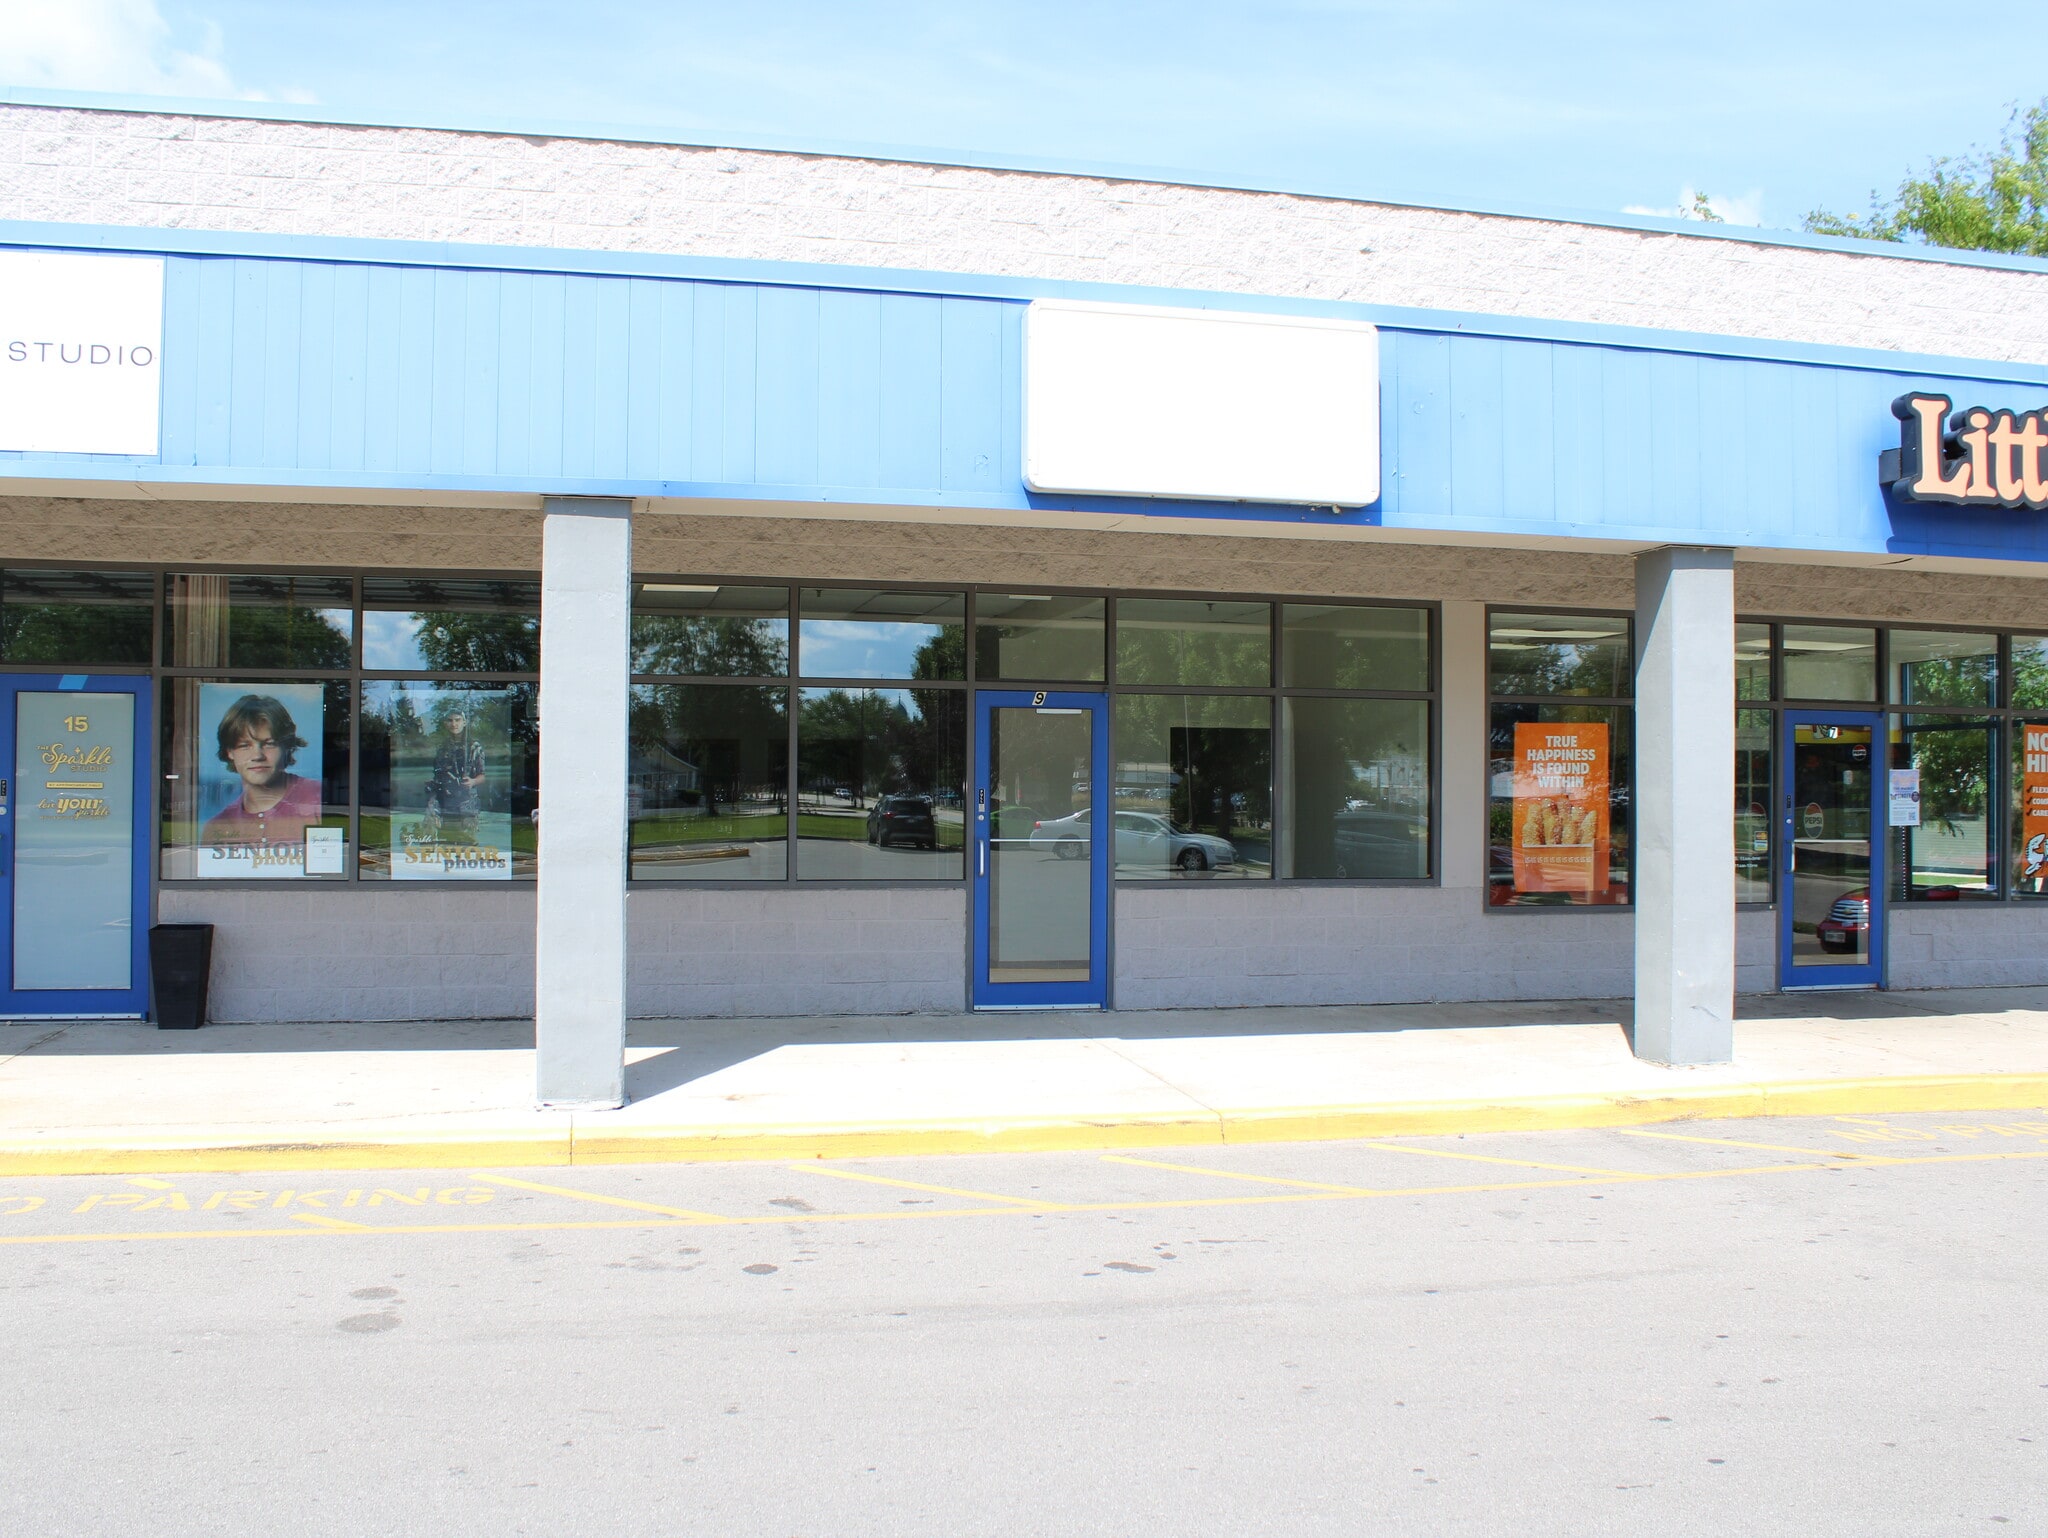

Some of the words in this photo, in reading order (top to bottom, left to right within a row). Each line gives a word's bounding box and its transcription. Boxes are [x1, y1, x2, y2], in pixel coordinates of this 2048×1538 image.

[8, 341, 153, 366] STUDIO
[1907, 393, 2048, 506] Litt
[1035, 692, 1044, 704] 9
[64, 716, 89, 732] 15
[1545, 735, 1578, 748] TRUE
[42, 743, 113, 773] Sparkle
[1527, 749, 1596, 761] HAPPINESS
[2027, 754, 2048, 772] HI
[1532, 763, 1544, 775] IS
[1547, 763, 1590, 775] FOUND
[1538, 776, 1584, 788] WITHIN
[57, 798, 103, 813] your
[1805, 816, 1823, 825] PEPSI
[405, 846, 499, 863] SENIOR
[444, 855, 506, 872] photos
[72, 1187, 496, 1214] PARKING
